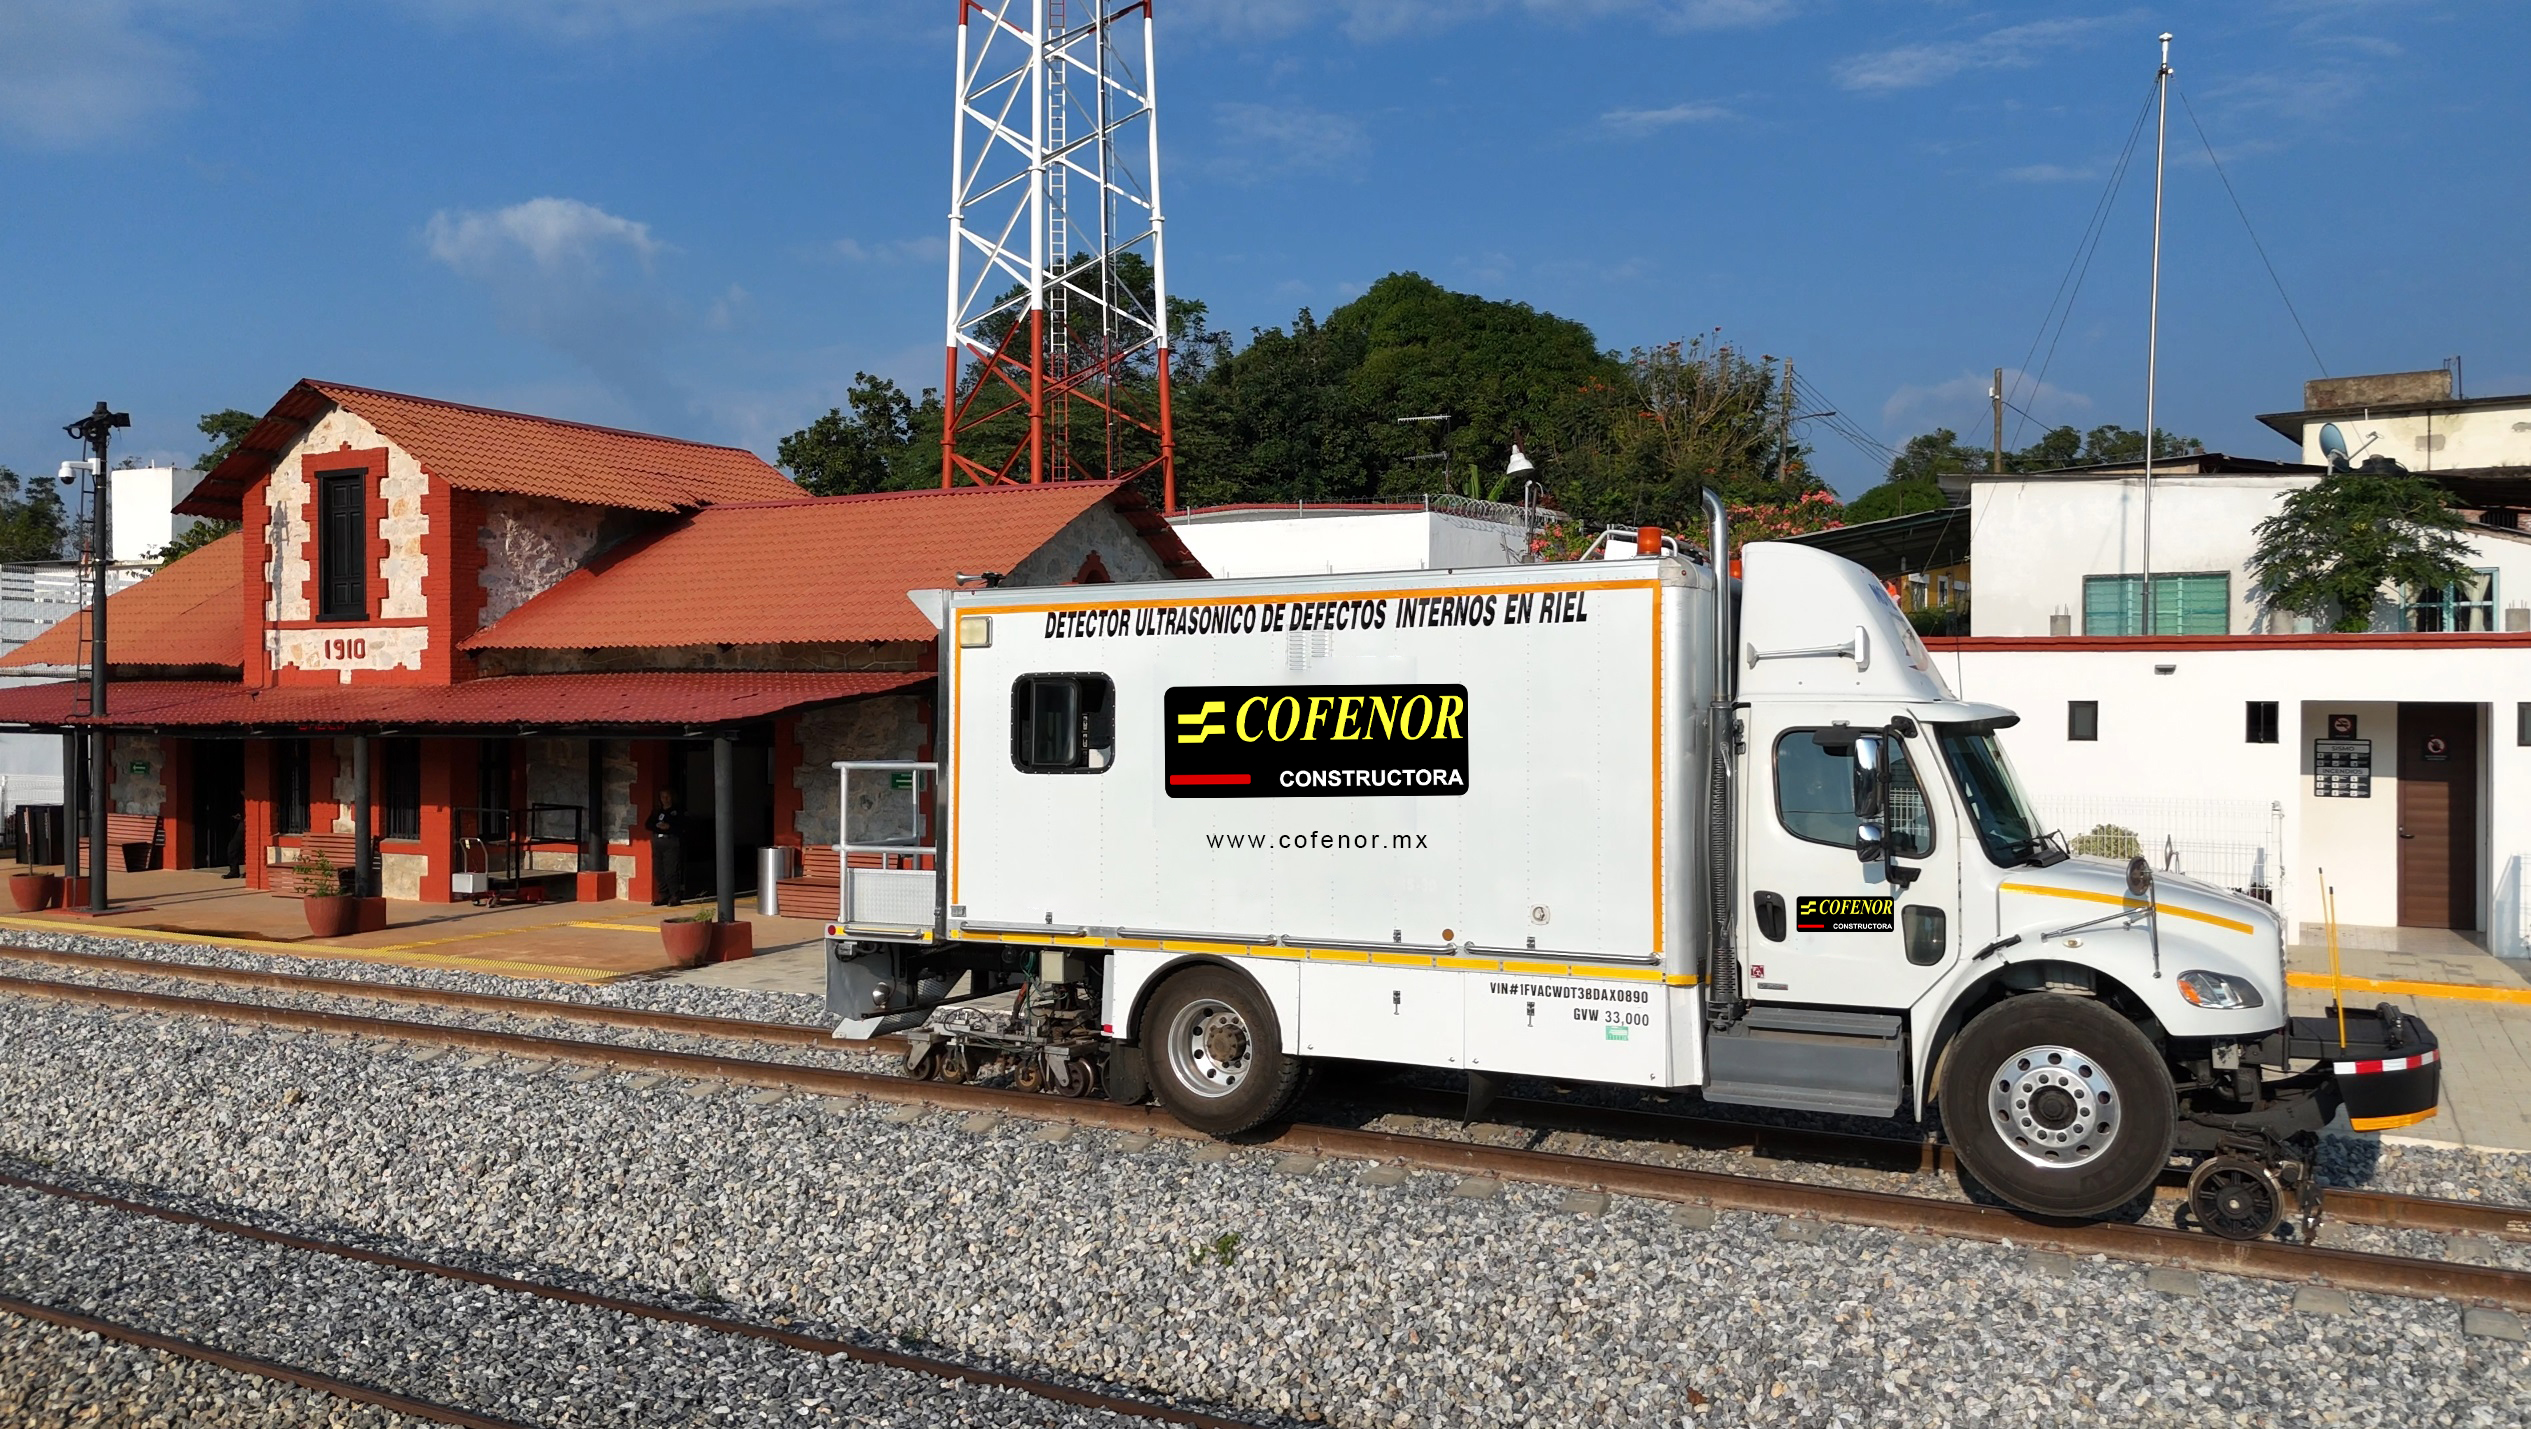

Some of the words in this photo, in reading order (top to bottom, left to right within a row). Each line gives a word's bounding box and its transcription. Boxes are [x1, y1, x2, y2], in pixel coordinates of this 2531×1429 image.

[1044, 609, 1131, 639] DETECTOR
[1135, 604, 1257, 637] ULTRASONICO
[1260, 603, 1287, 633] DE
[1288, 600, 1387, 632] DEFECTOS
[1395, 595, 1497, 629] INTERNOS
[1503, 593, 1535, 625] EN
[1538, 591, 1588, 624] RIEL
[324, 638, 366, 660] 1910
[1236, 694, 1464, 743] COFENOR
[1279, 768, 1464, 788] CONSTRUCTORA
[1205, 830, 1428, 849] www.cofenor.mx
[1819, 899, 1893, 915] COFENOR
[1832, 922, 1893, 930] CONSTRUCTORA
[1573, 1007, 1599, 1022] GVW
[1604, 1010, 1650, 1027] 33,000
